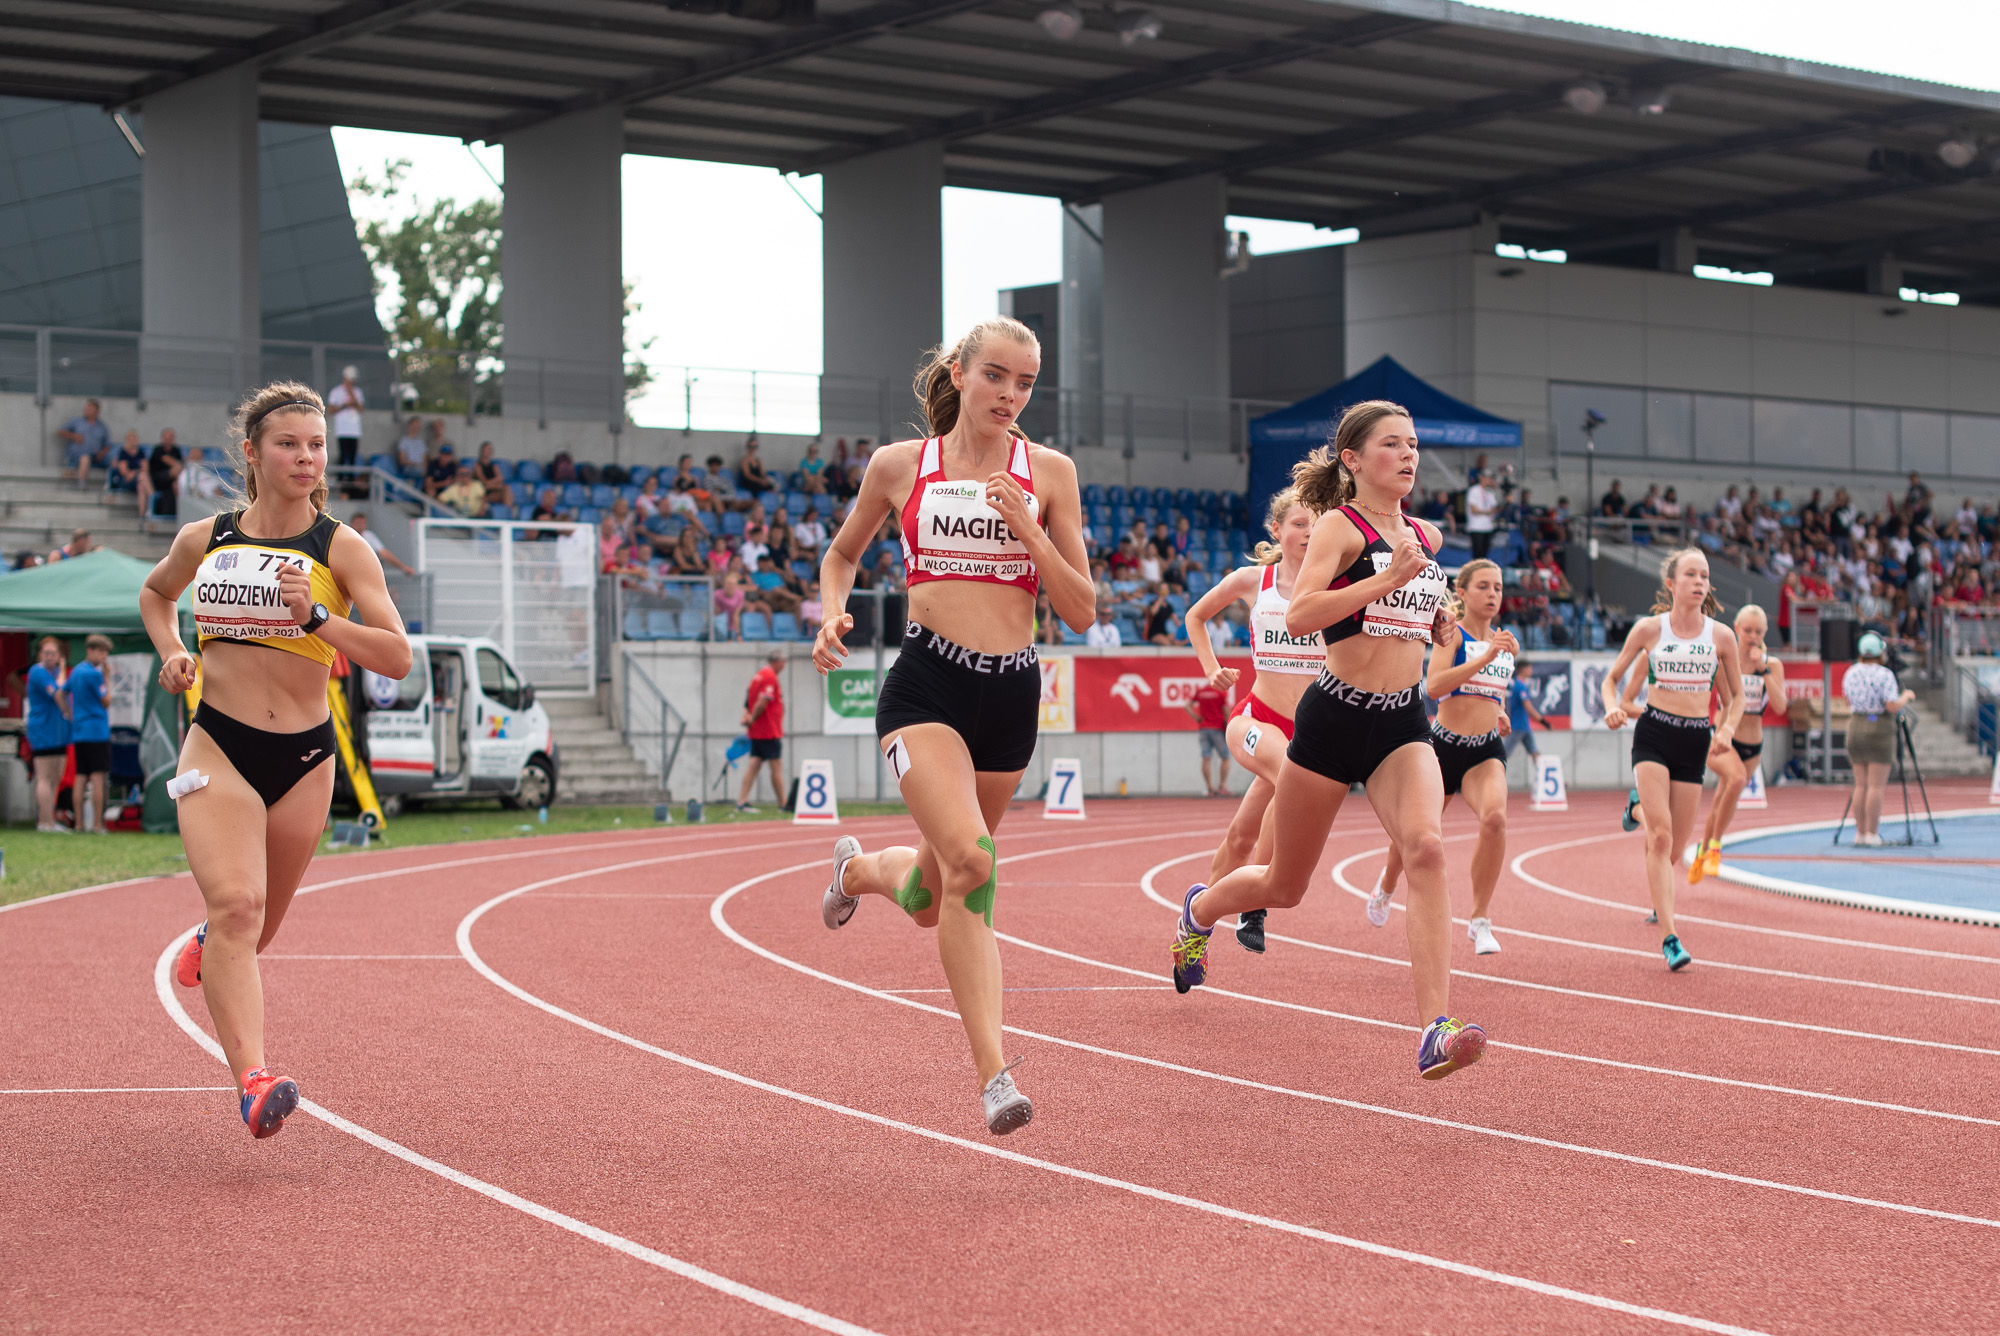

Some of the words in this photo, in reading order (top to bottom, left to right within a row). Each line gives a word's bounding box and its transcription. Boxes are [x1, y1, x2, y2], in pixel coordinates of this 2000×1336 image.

[930, 486, 978, 498] TOTALbet
[950, 552, 995, 560] MISTRZOSTWA
[924, 559, 998, 574] WŁOCŁAWEK
[1001, 563, 1023, 574] 2021
[198, 579, 290, 607] GOŹDZIEWI
[224, 618, 267, 626] MISTRZOSTWA
[201, 625, 271, 637] WŁOCŁAWEK
[274, 628, 299, 637] 2021
[1264, 629, 1319, 647] BIAŁEK
[927, 632, 995, 674] NIKE
[999, 641, 1038, 674] PRO
[1689, 643, 1712, 656] 287
[1258, 659, 1305, 668] WŁOCŁAWEK
[1306, 661, 1322, 669] 2021
[1658, 659, 1712, 674] STRZEŻYSZ
[1316, 668, 1367, 706] NIKE
[1365, 687, 1413, 711] PRO
[1651, 709, 1684, 727] NIKE
[1684, 718, 1710, 728] PRO
[1245, 730, 1257, 749] 5
[1457, 733, 1488, 748] PRO
[1055, 771, 1076, 806] 7
[1544, 767, 1559, 797] 5
[805, 773, 827, 809] 8
